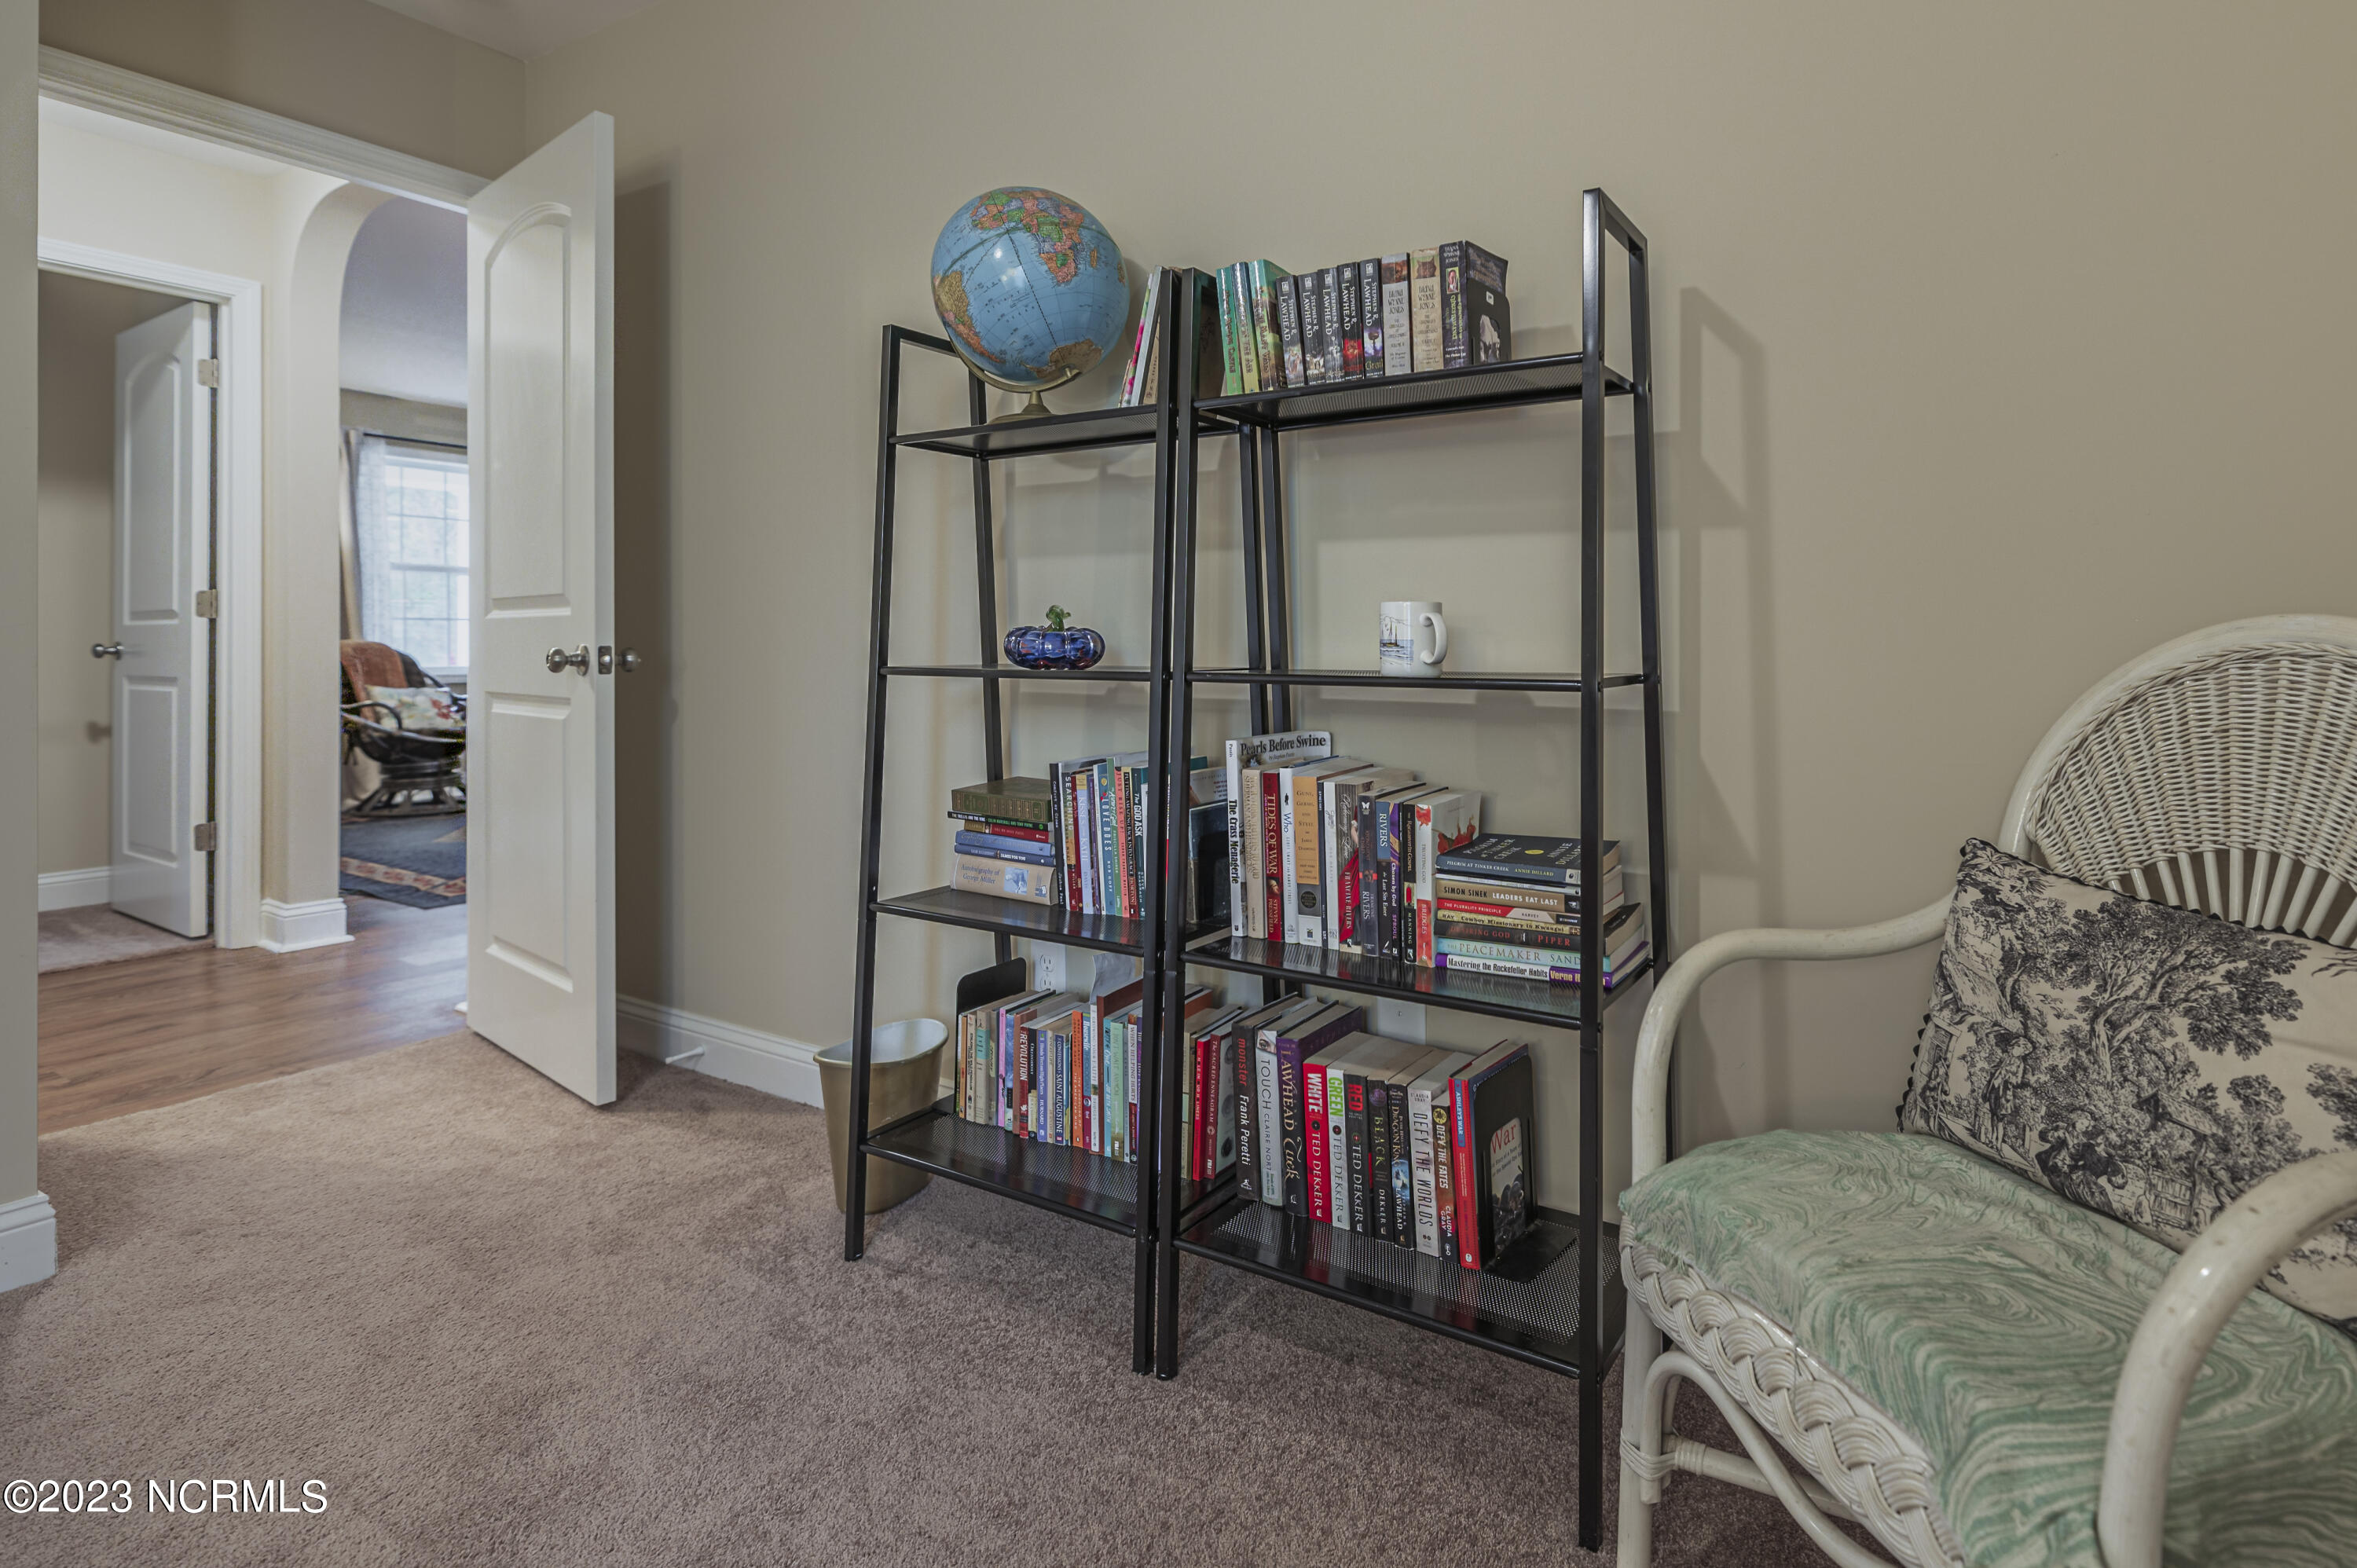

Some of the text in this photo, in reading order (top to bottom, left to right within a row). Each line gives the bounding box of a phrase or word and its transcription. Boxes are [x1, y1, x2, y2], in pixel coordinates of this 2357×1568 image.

[1281, 295, 1291, 341] LAWHEAD
[1303, 292, 1313, 338] LAWHEAD
[1323, 289, 1332, 335] LAWHEAD
[1342, 283, 1351, 330] LAWHEAD
[1364, 278, 1373, 327] LAWHEAD
[1241, 734, 1326, 756] Pearls Before Swine
[1102, 799, 1112, 851] LOVE DOES
[1229, 800, 1240, 885] The Crass Menagerie
[1267, 793, 1277, 874] TIDES OF WAR
[1284, 812, 1292, 833] Who
[962, 864, 994, 875] Autobiography
[963, 873, 979, 881] George
[1444, 886, 1487, 898] SIMON SINEK
[1493, 892, 1523, 902] LEADERS
[1449, 926, 1510, 939] DESIRING GOD
[1487, 919, 1524, 929] Missionary
[1538, 935, 1571, 946] PIPER
[1448, 958, 1480, 969] Mastering
[1493, 963, 1527, 975] Rockefeller
[1529, 968, 1548, 979] Habits
[1460, 943, 1540, 962] PEACEMAKER
[1550, 954, 1581, 965] SAND
[1550, 969, 1573, 982] Verne
[1238, 1038, 1251, 1166] monster Frank Peretti
[1260, 1060, 1271, 1110] TOUCH
[1281, 1050, 1295, 1131] LAWHEAD
[1307, 1073, 1323, 1114] WHITE
[1328, 1076, 1343, 1117] GREEN
[1348, 1084, 1364, 1111] RED
[1284, 1137, 1303, 1188] Tuck
[1373, 1117, 1385, 1167] BLACK
[1436, 1125, 1449, 1189] DEFY THE FATES
[1491, 1124, 1516, 1155] War
[1312, 1132, 1323, 1207] TED DEKKER
[1333, 1136, 1343, 1212] TED DEKKER
[1352, 1144, 1364, 1221] TED DEKKER
[1413, 1112, 1433, 1227] DEFY THE WORLDS
